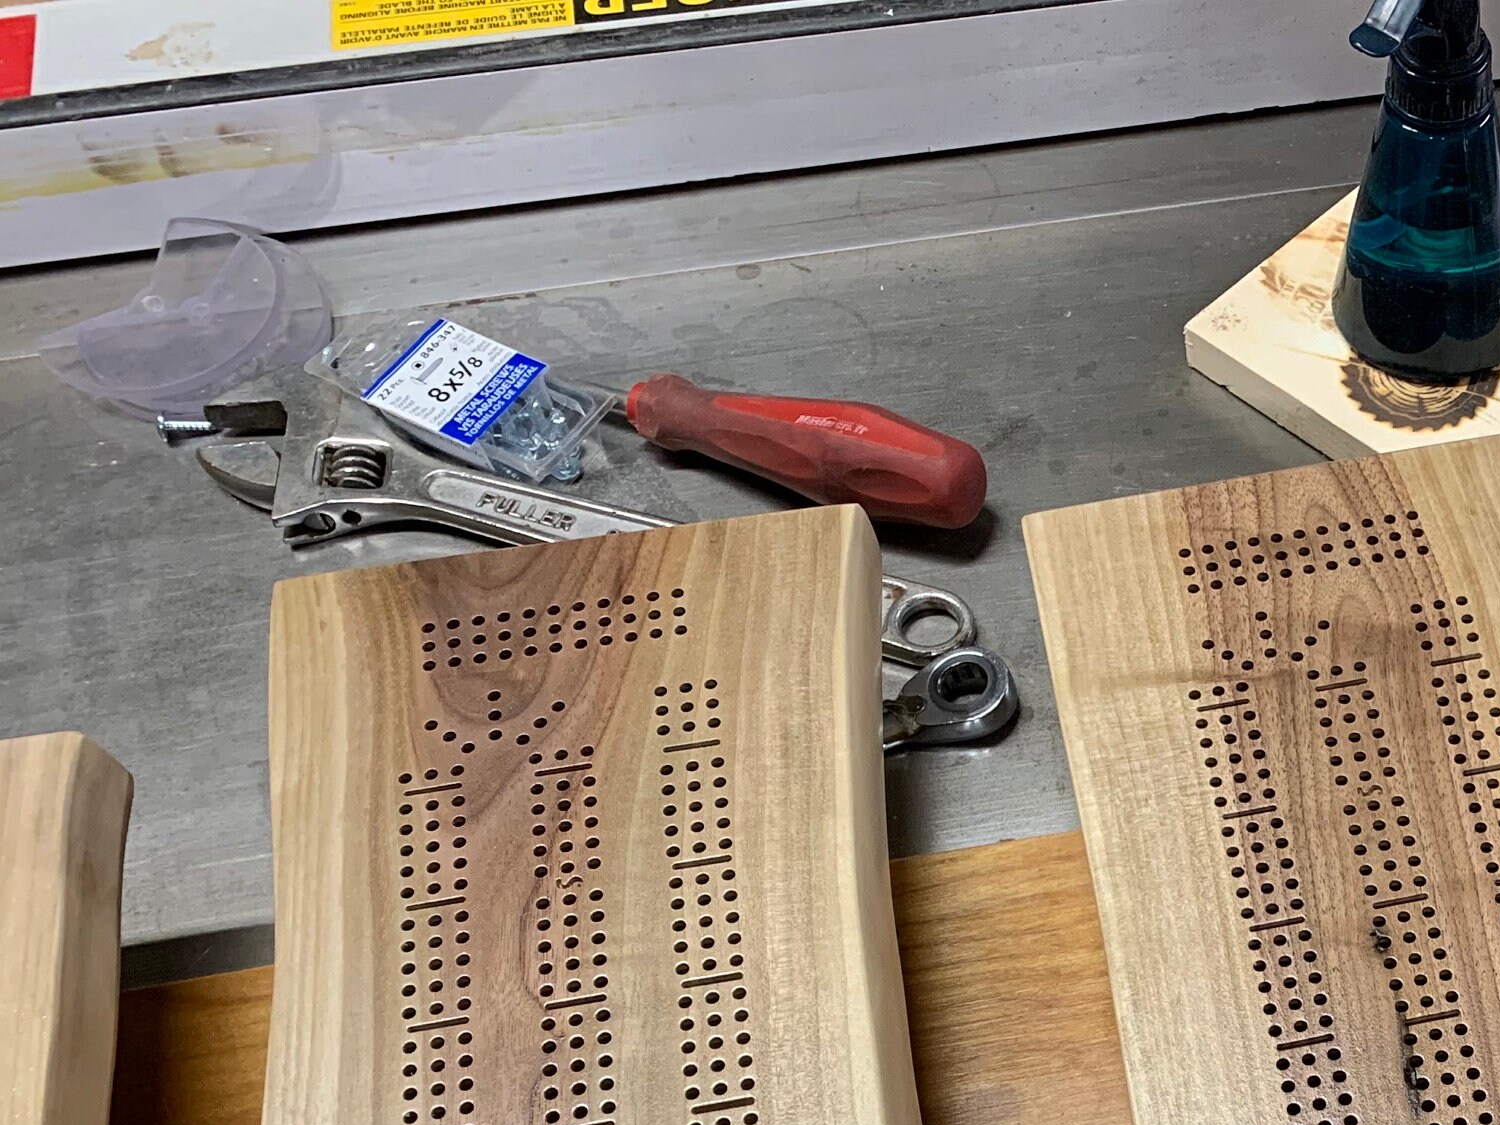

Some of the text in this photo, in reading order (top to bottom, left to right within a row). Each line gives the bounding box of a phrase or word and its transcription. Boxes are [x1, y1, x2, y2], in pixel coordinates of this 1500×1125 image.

[378, 1, 412, 9] BLADE
[395, 5, 435, 14] BEFORE
[440, 0, 486, 9] MACHINE
[511, 5, 539, 14] LAME
[340, 9, 391, 20] ALIGNING
[474, 14, 507, 23] GUIDE
[405, 20, 452, 31] REFENTE
[488, 20, 528, 28] METTRE
[385, 31, 420, 40] AVANT
[425, 26, 467, 36] MARCHE
[420, 325, 456, 359] 846-347
[378, 388, 393, 401] 22
[454, 397, 485, 424] METAL
[480, 364, 514, 398] SCREWS
[457, 417, 476, 432] VIS
[471, 363, 528, 421] TARAUDEUSES
[464, 400, 506, 438] TORNILLOS
[502, 389, 517, 401] DE
[513, 366, 539, 389] METAL
[476, 491, 577, 532] FULLER
